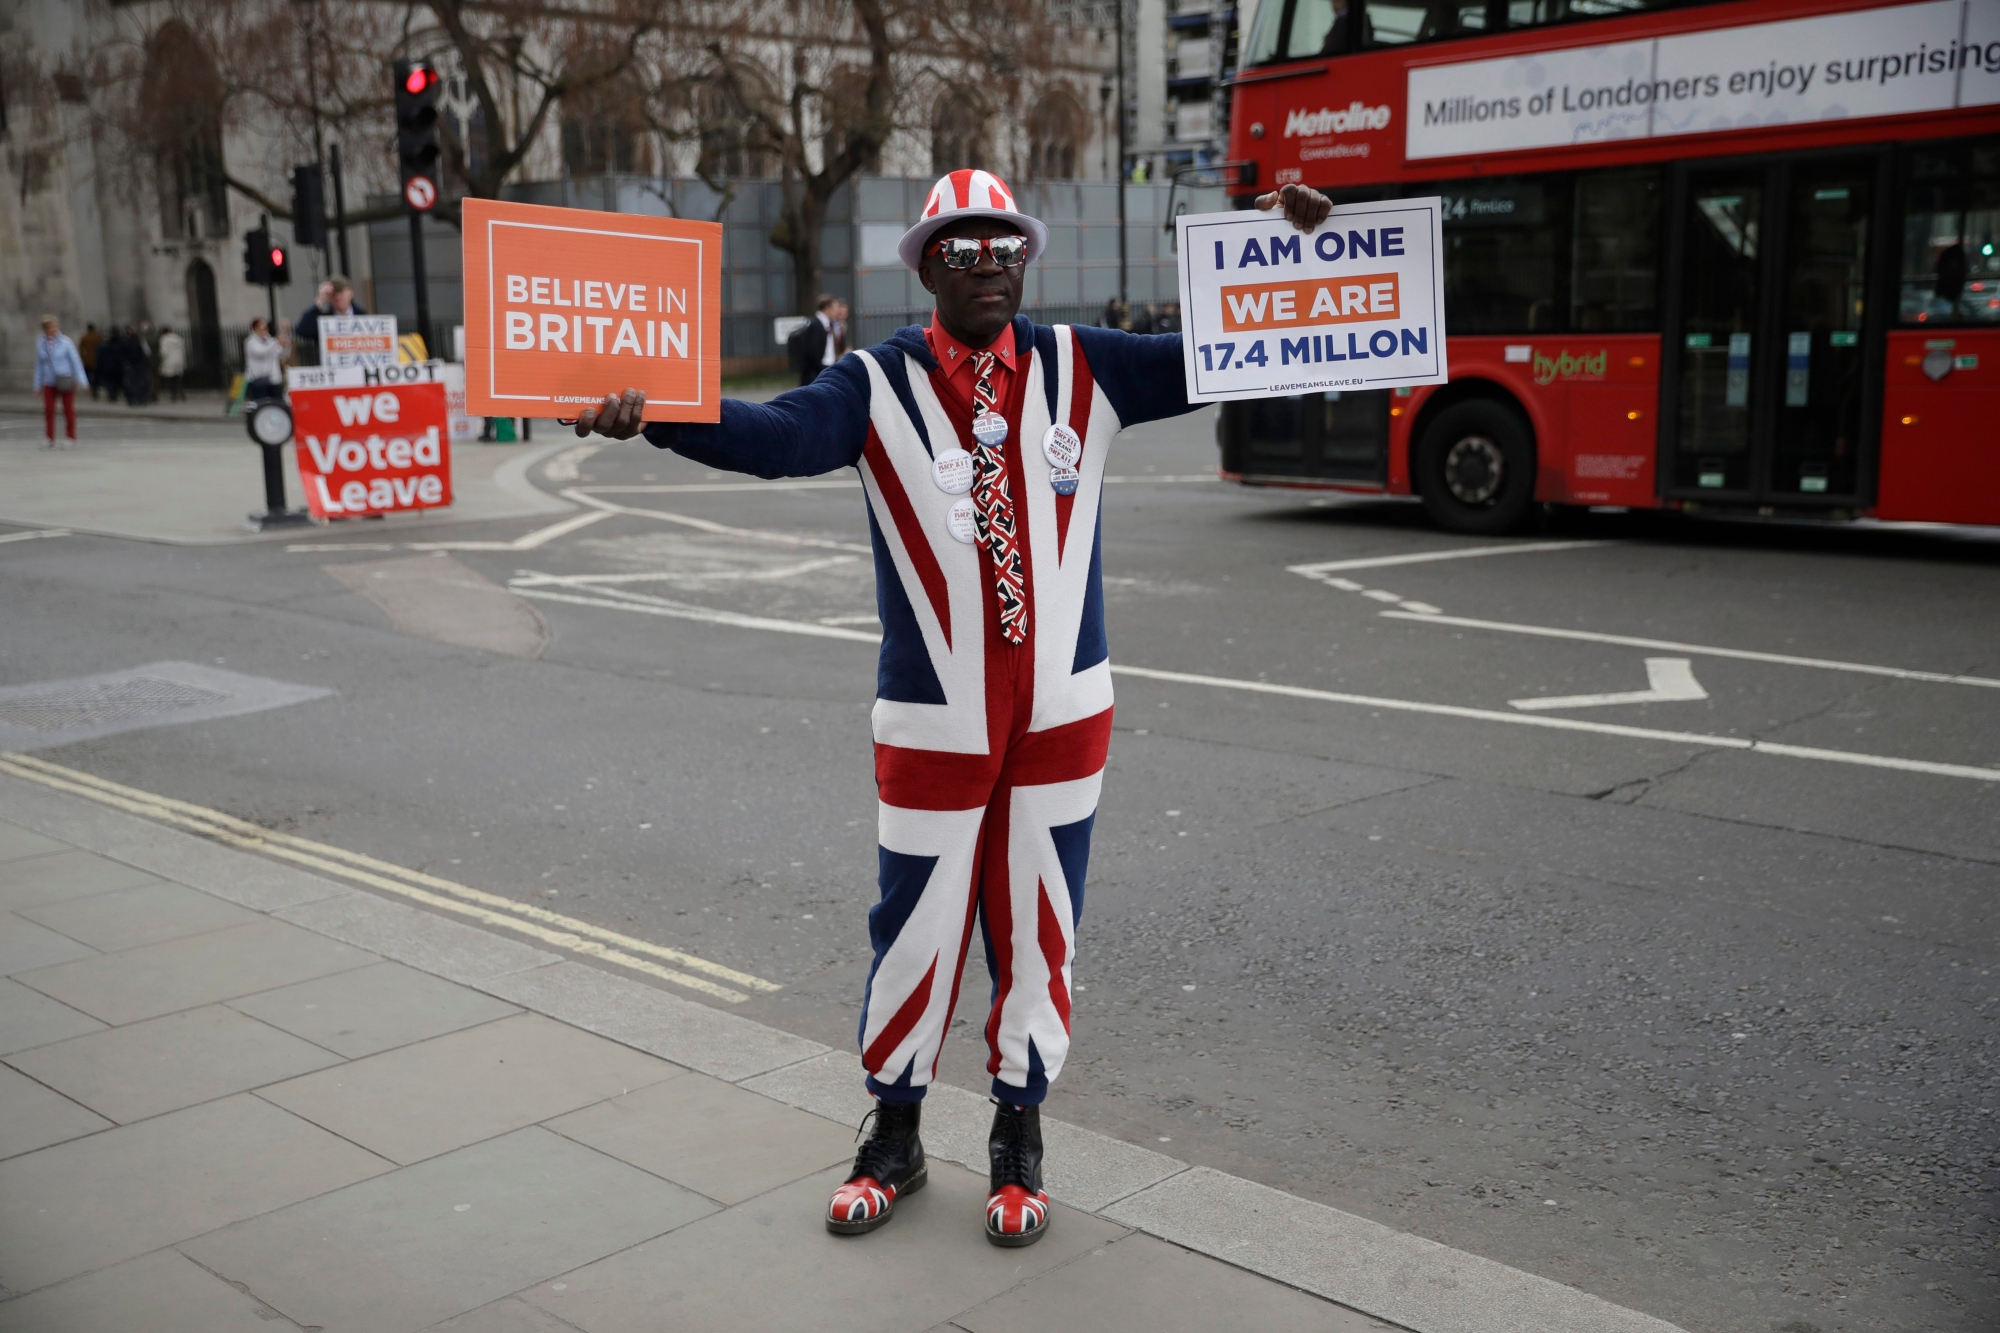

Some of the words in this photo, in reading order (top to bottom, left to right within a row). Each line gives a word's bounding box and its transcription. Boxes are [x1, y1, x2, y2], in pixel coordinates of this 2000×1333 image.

[1424, 96, 1520, 127] Millions
[1528, 86, 1554, 116] of
[1562, 75, 1719, 112] Londoners
[1728, 60, 1816, 98] enjoy
[1824, 39, 2000, 86] surprising
[1283, 101, 1391, 138] Metroline
[1441, 196, 1467, 220] 24
[1215, 241, 1224, 270] I
[1238, 234, 1301, 268] AM
[1314, 227, 1405, 262] ONE
[507, 274, 647, 312] BELIEVE
[658, 286, 686, 315] IN
[1226, 289, 1297, 324] WE
[1309, 282, 1395, 319] ARE
[324, 319, 391, 335] LEAVE
[332, 338, 386, 351] MEANS
[505, 311, 688, 359] BRITAIN
[1198, 340, 1269, 372] 17.4
[1280, 327, 1428, 366] MILLON
[1533, 348, 1607, 386] hybrid
[364, 364, 437, 387] HOOT
[1269, 378, 1363, 392] LEAVEMEANSLEAVE.EU
[333, 391, 401, 428] we
[305, 425, 441, 475] Voted
[313, 474, 444, 513] Leave
